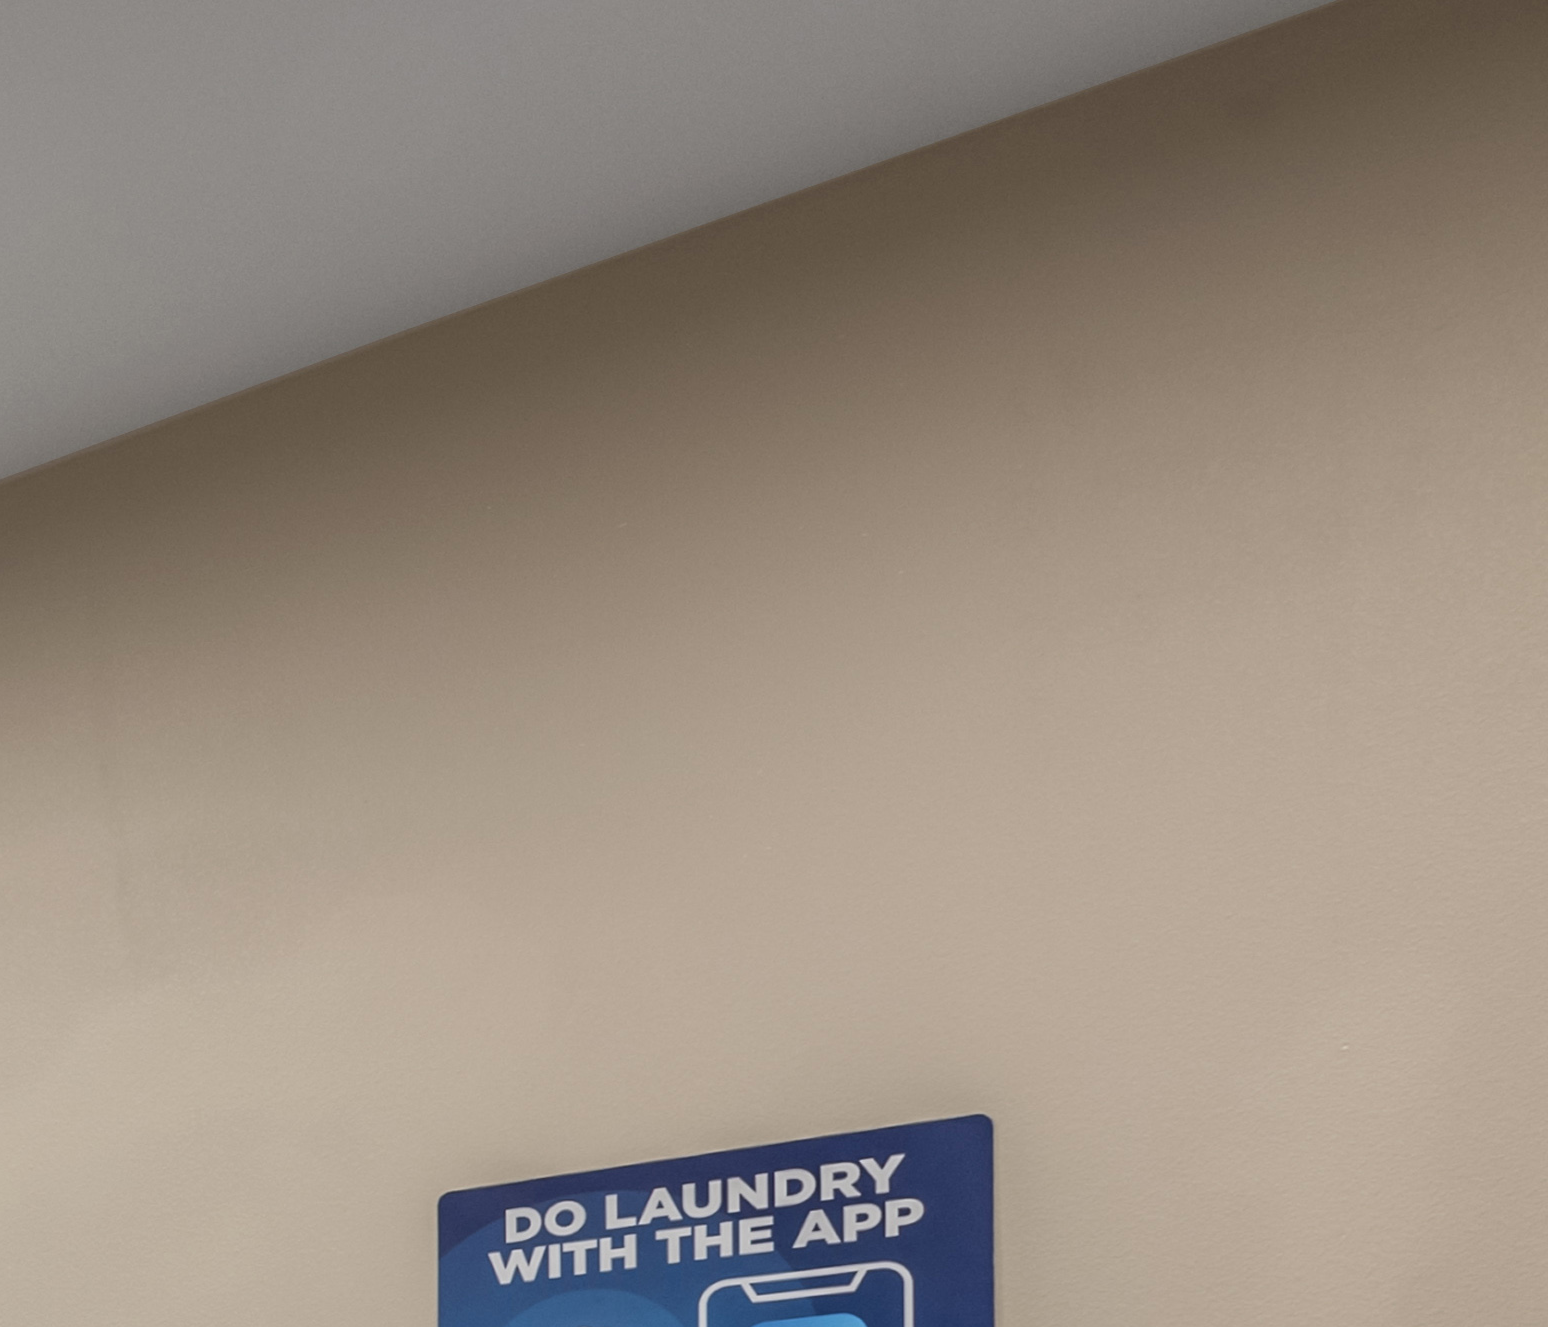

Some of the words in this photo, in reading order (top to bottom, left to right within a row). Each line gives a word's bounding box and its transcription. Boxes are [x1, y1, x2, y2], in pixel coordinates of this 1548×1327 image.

[488, 1235, 637, 1285] WITH
[656, 1216, 774, 1264] THE
[792, 1199, 924, 1249] APP
[505, 1201, 586, 1243] DO
[605, 1154, 906, 1229] LAUNDRY
